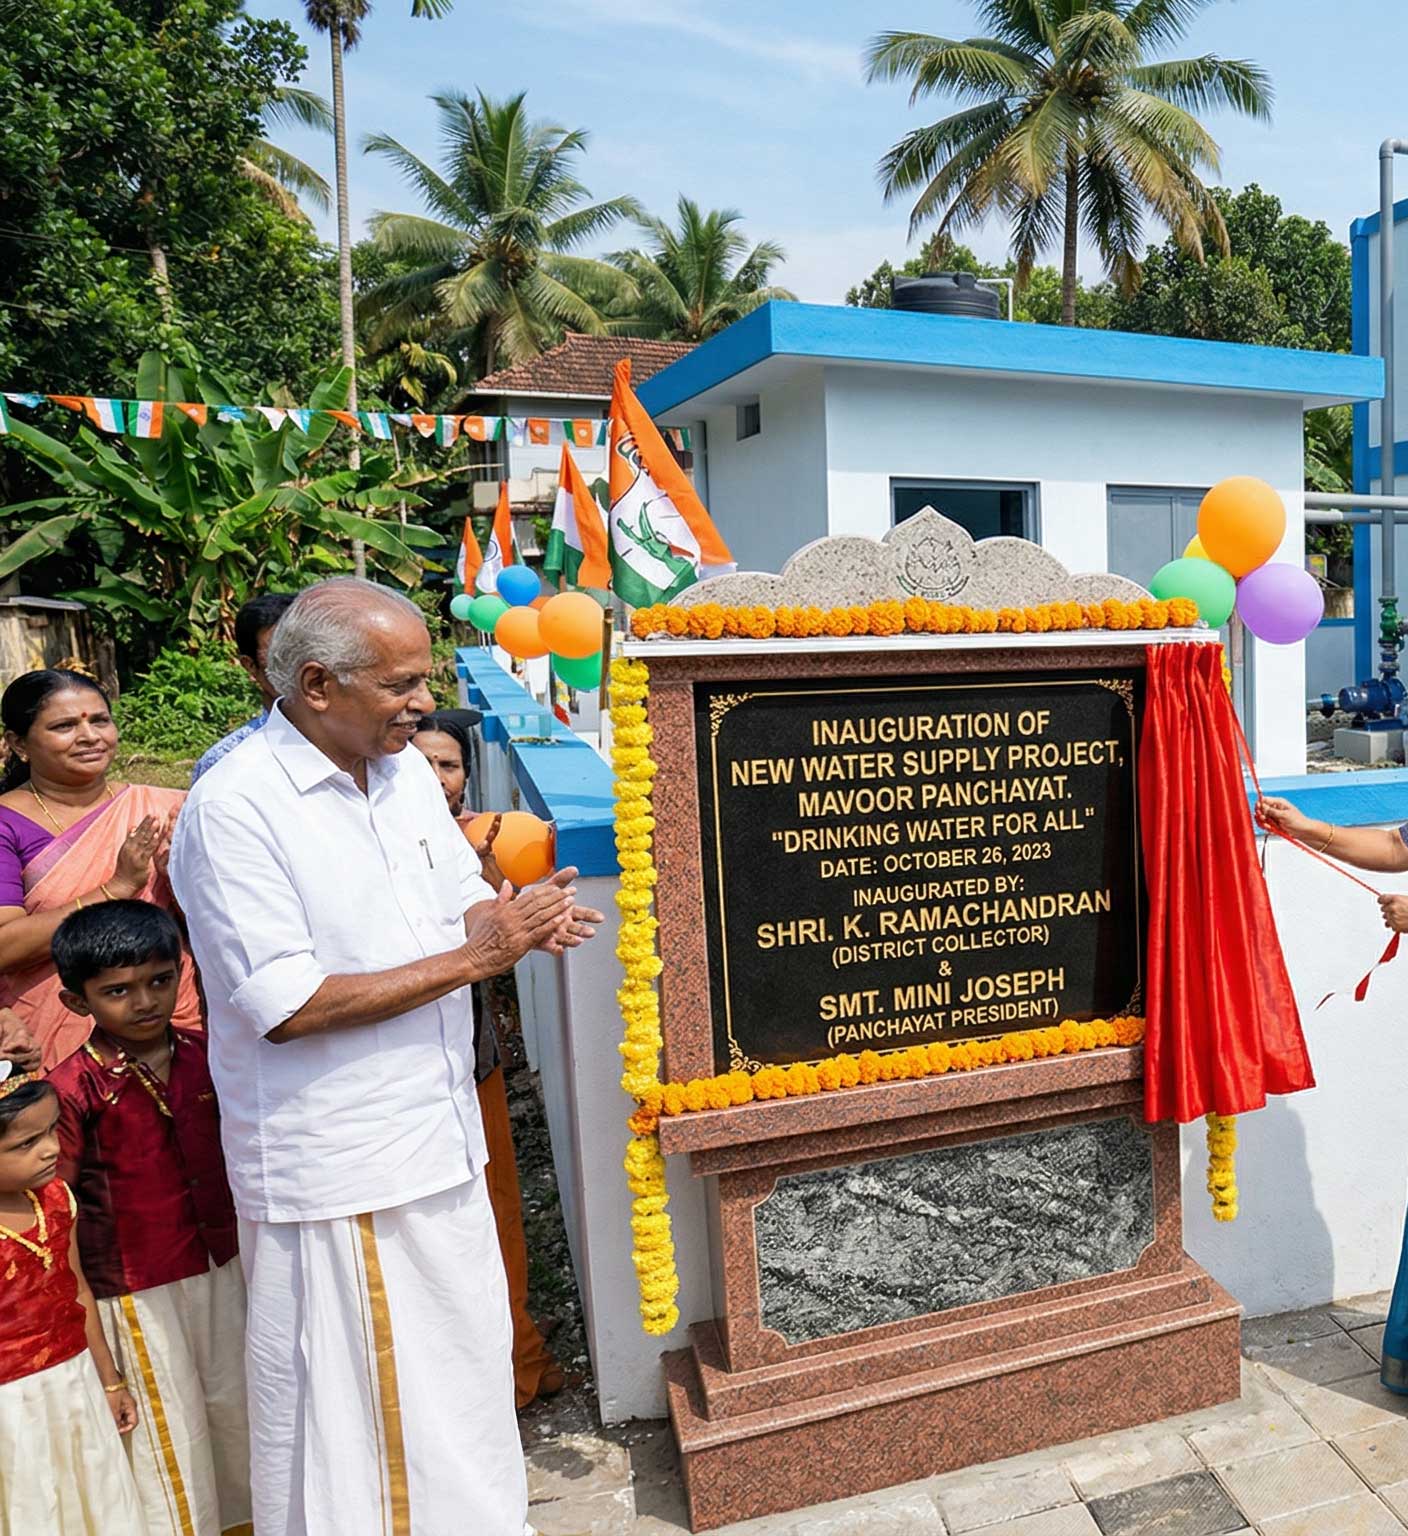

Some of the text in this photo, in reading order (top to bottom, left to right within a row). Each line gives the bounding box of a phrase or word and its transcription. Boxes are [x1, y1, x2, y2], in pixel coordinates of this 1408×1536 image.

[812, 711, 1050, 746] INAUGURATION OF
[732, 741, 1123, 785] NEW WATER SUPPLY PROJECT,
[799, 775, 1071, 817] MAVOOR PANCHAYAT.
[773, 808, 1094, 852] "DRINKING WATER FOR ALL"
[821, 842, 1051, 878] DATE: OCTOBER 26, 2023
[853, 876, 1024, 907] INAUGURATED BY:
[758, 890, 1110, 948] SHRI. K. RAMACHANDRAN
[831, 925, 1049, 967] (DISTRICT COLLECTOR)
[939, 961, 952, 976] &
[820, 968, 1064, 1021] SMT. MINI JOSEPH
[827, 998, 1059, 1048] (PANCHAYAT PRESIDENT)
